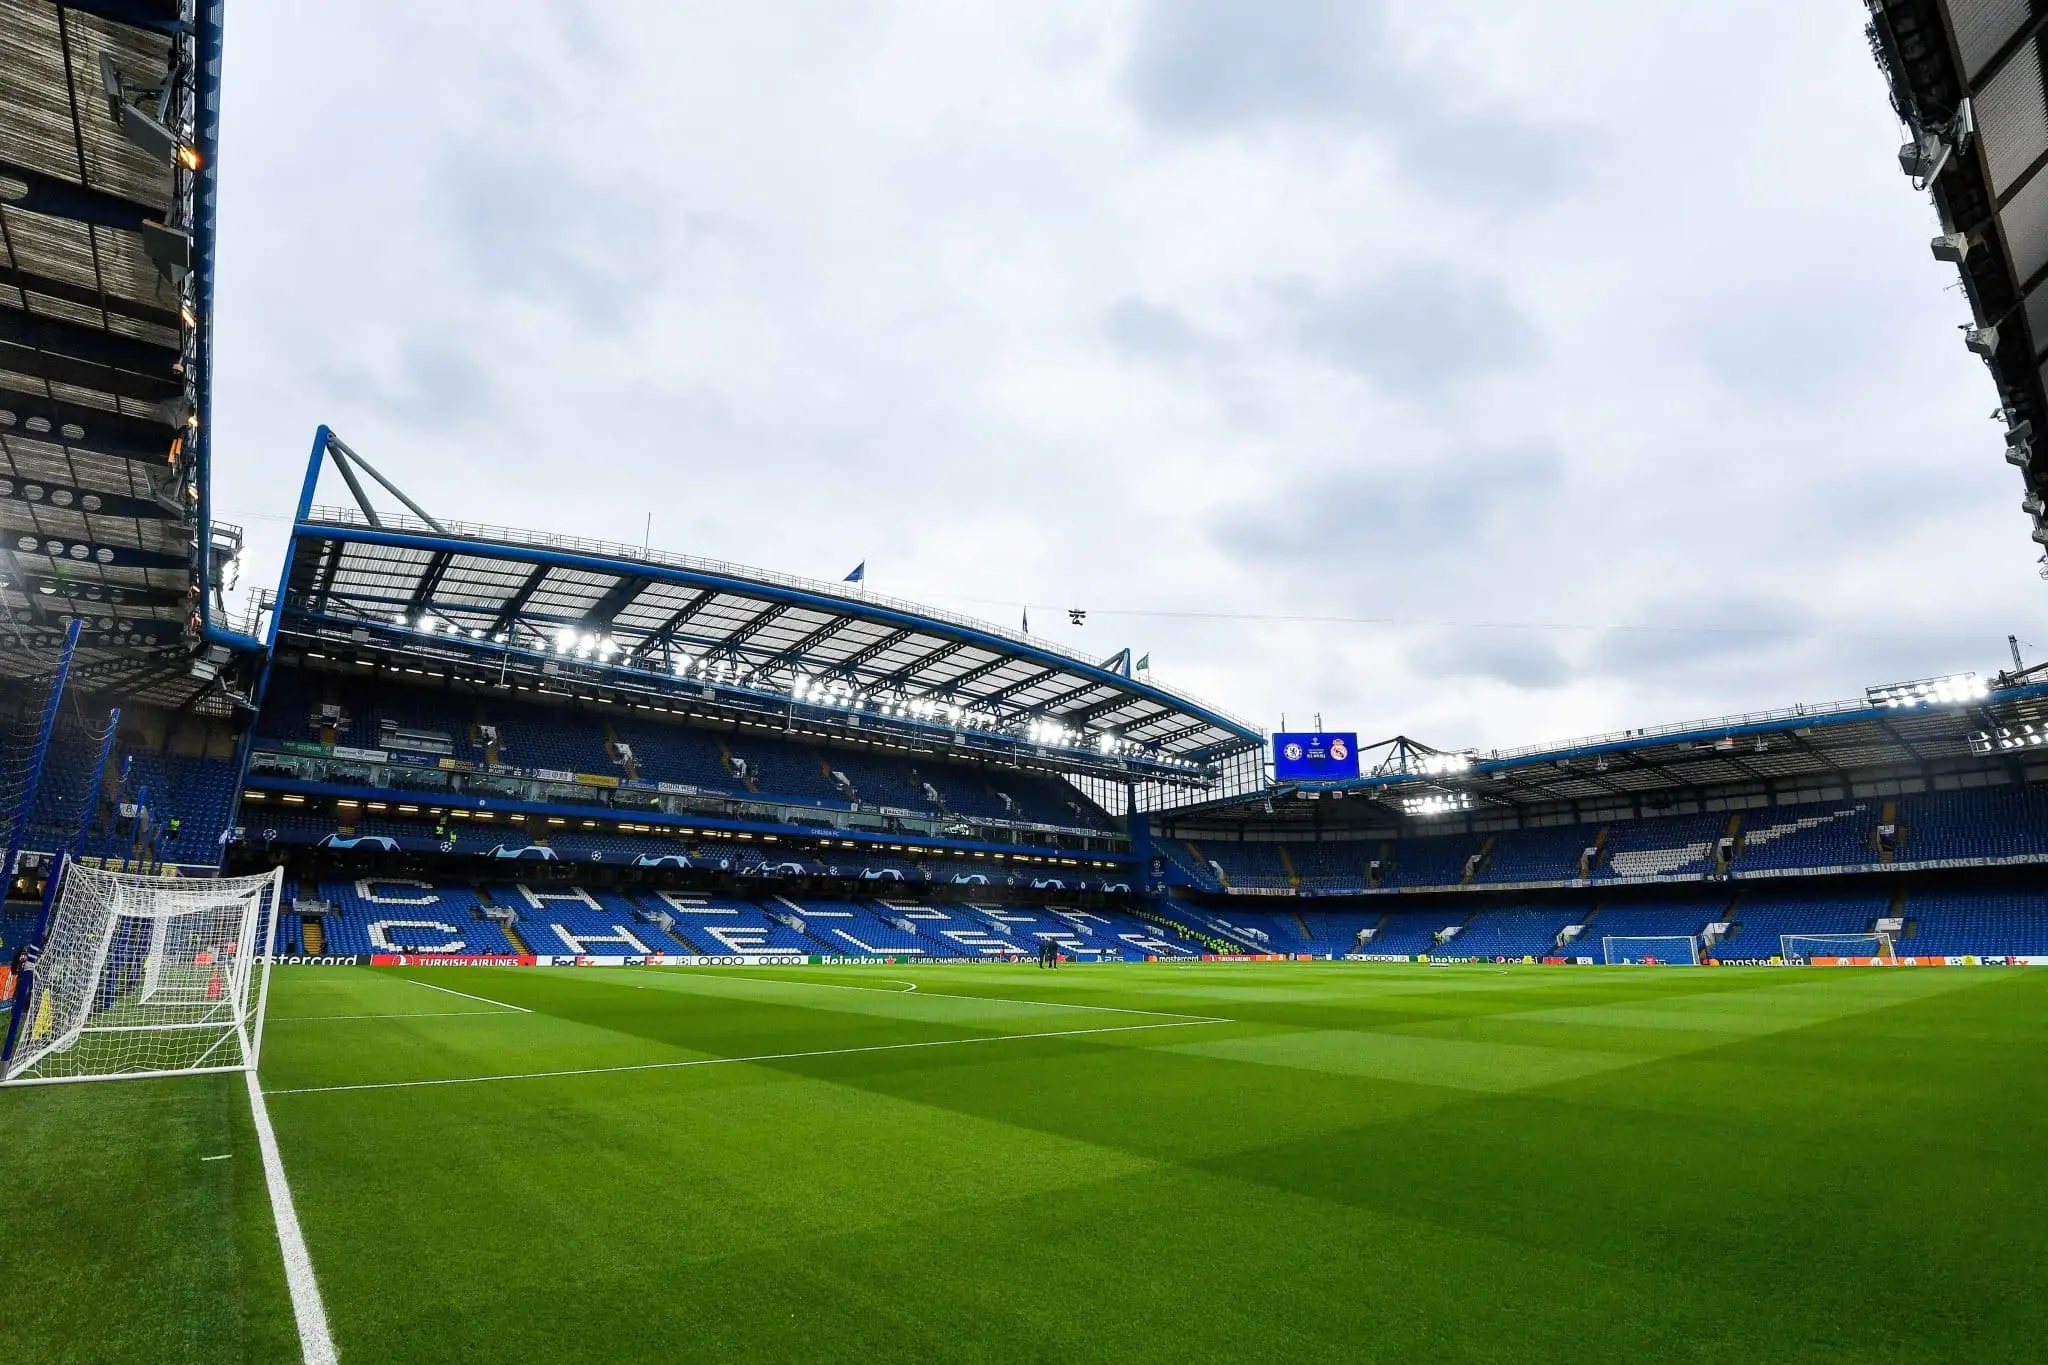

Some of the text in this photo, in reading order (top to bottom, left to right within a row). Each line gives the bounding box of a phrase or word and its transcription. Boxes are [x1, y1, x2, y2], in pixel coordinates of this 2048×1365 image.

[1872, 862, 1917, 873] SUPER
[1920, 857, 1984, 869] FRANKIE
[1744, 868, 1780, 879] CHELSEA
[252, 953, 358, 966] astercard
[419, 958, 519, 967] TURKISH AIRLINES
[551, 956, 595, 967] FedEx
[623, 956, 664, 967] FedEx
[821, 955, 884, 965] Heineken
[917, 956, 993, 965] UEFA CHAMPIONS LEAGUE
[1159, 955, 1199, 963] mastercard
[1507, 956, 1538, 965] pesi
